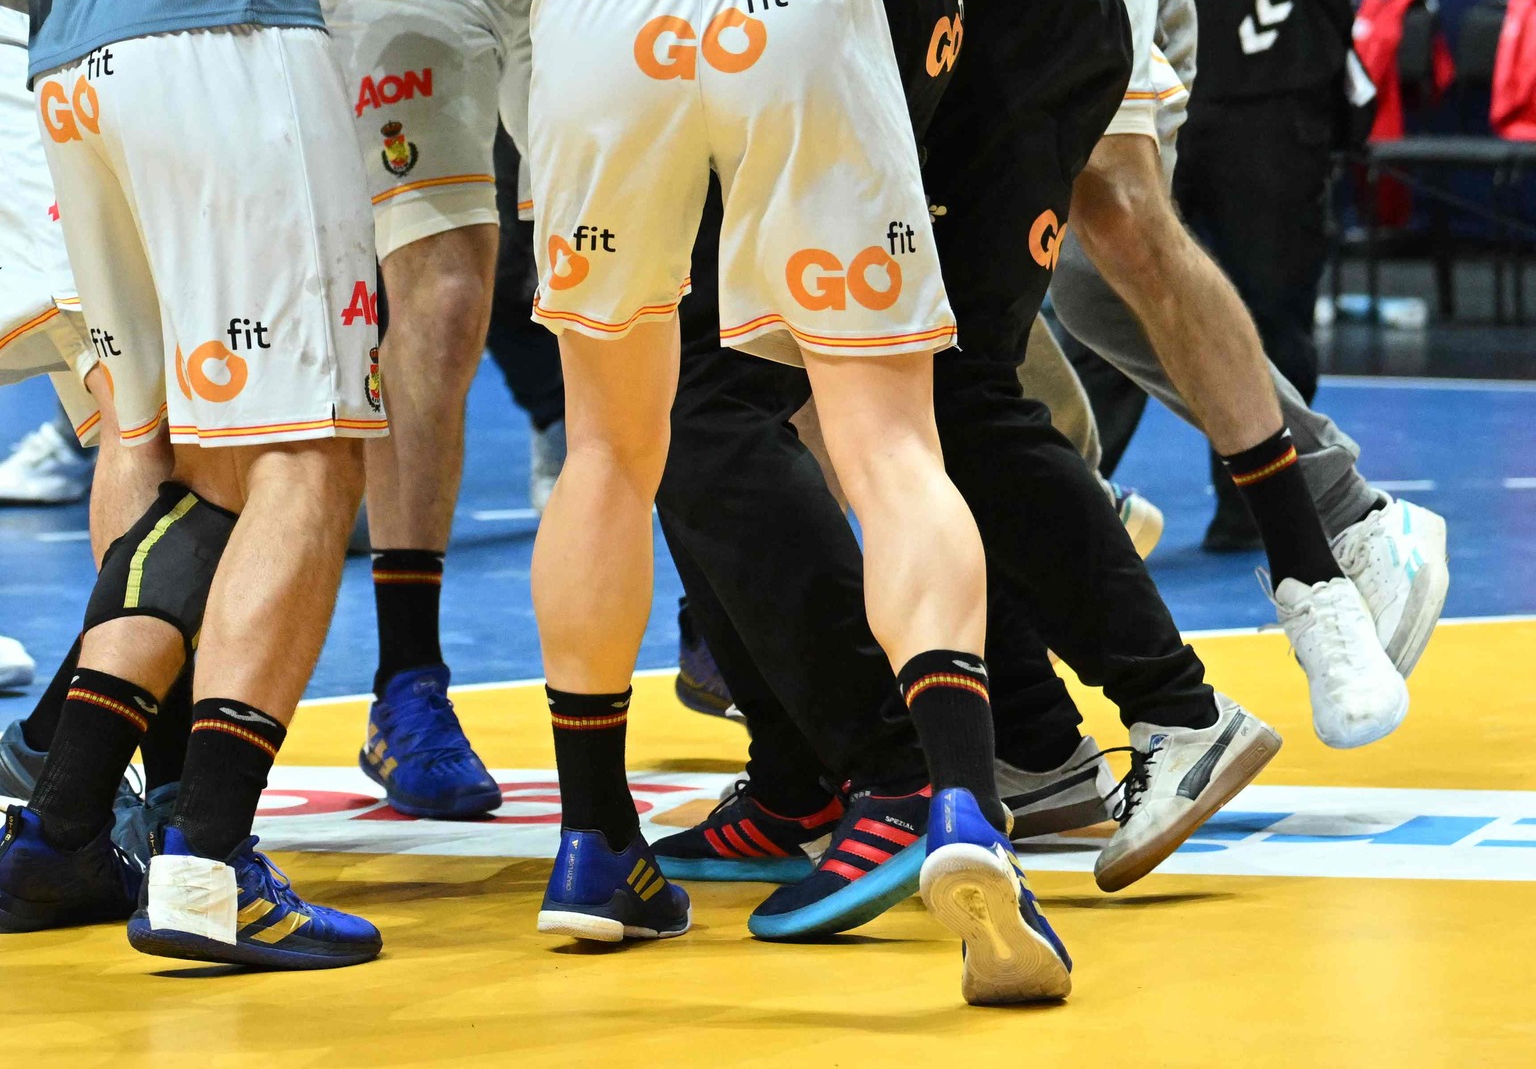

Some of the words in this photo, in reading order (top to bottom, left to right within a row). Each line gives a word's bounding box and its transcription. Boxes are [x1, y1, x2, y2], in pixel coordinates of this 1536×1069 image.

[633, 7, 767, 81] GO
[40, 75, 100, 144] GO
[87, 48, 115, 80] fit
[355, 68, 433, 119] AON
[573, 225, 617, 253] fit
[785, 245, 903, 311] GO
[887, 221, 916, 256] fit
[90, 328, 122, 359] fit
[175, 340, 248, 403] O
[227, 318, 271, 351] fit
[885, 815, 915, 831] SPEZIAL
